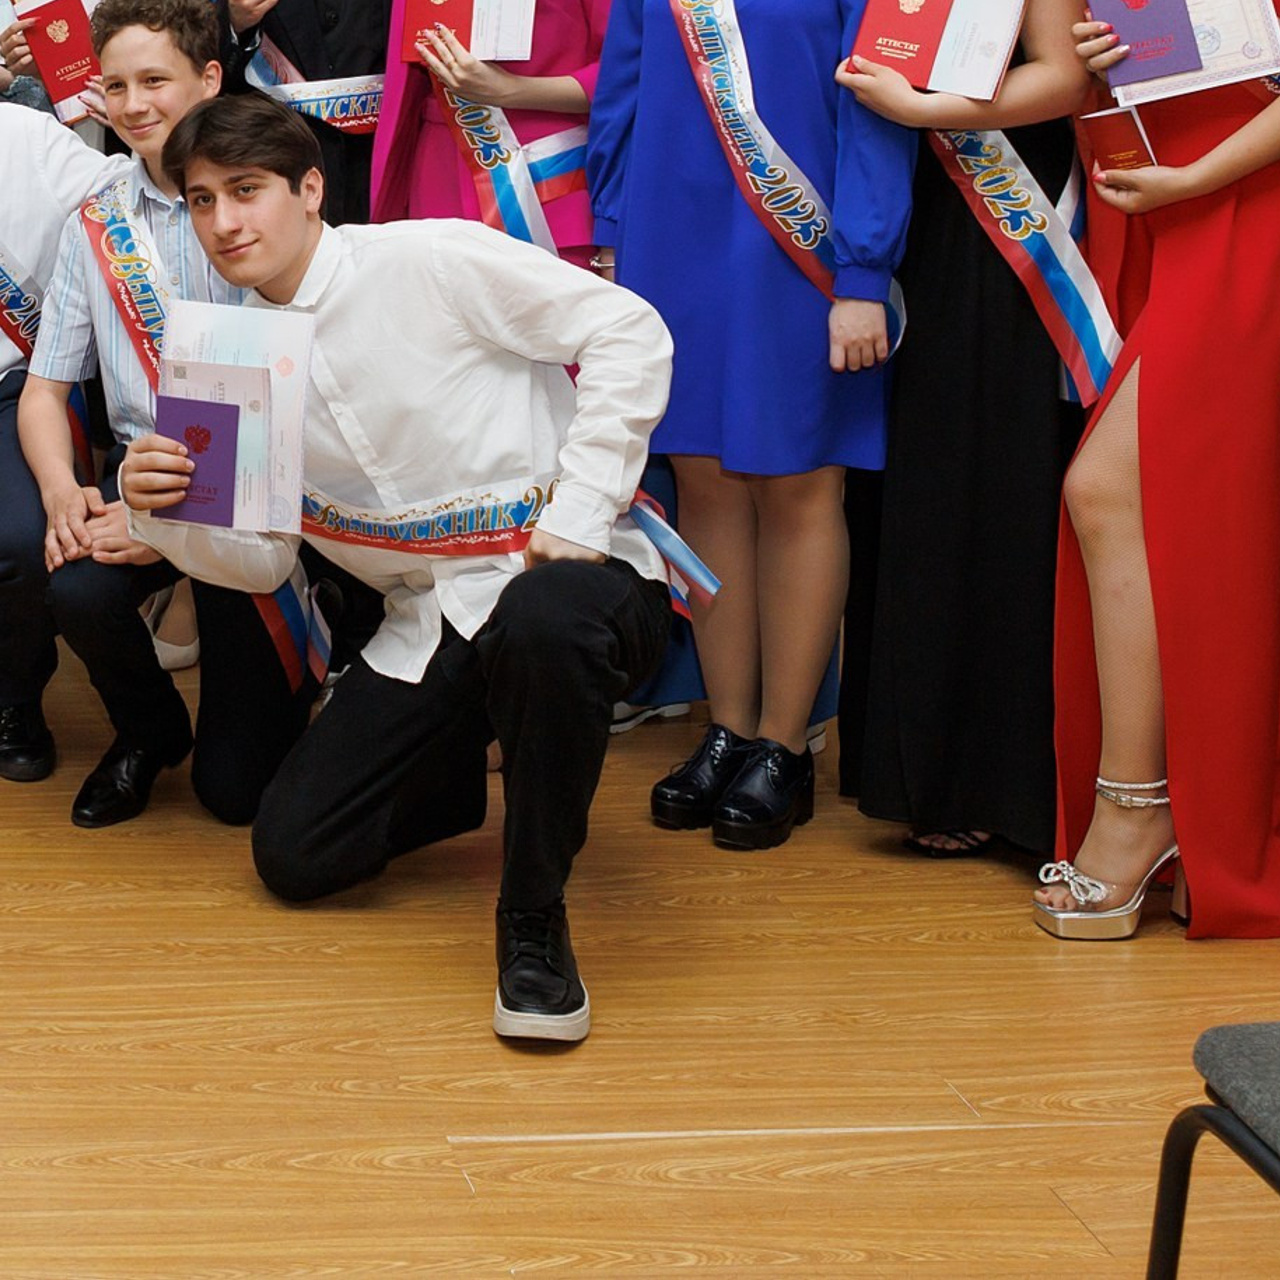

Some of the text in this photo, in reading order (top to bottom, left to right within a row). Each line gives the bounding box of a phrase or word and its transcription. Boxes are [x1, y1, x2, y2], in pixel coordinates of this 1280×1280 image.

[55, 57, 91, 77] АТТЕСТАТ
[875, 37, 920, 52] АТТЕСТАТ
[745, 165, 829, 250] 2023
[956, 144, 1049, 240] 2023
